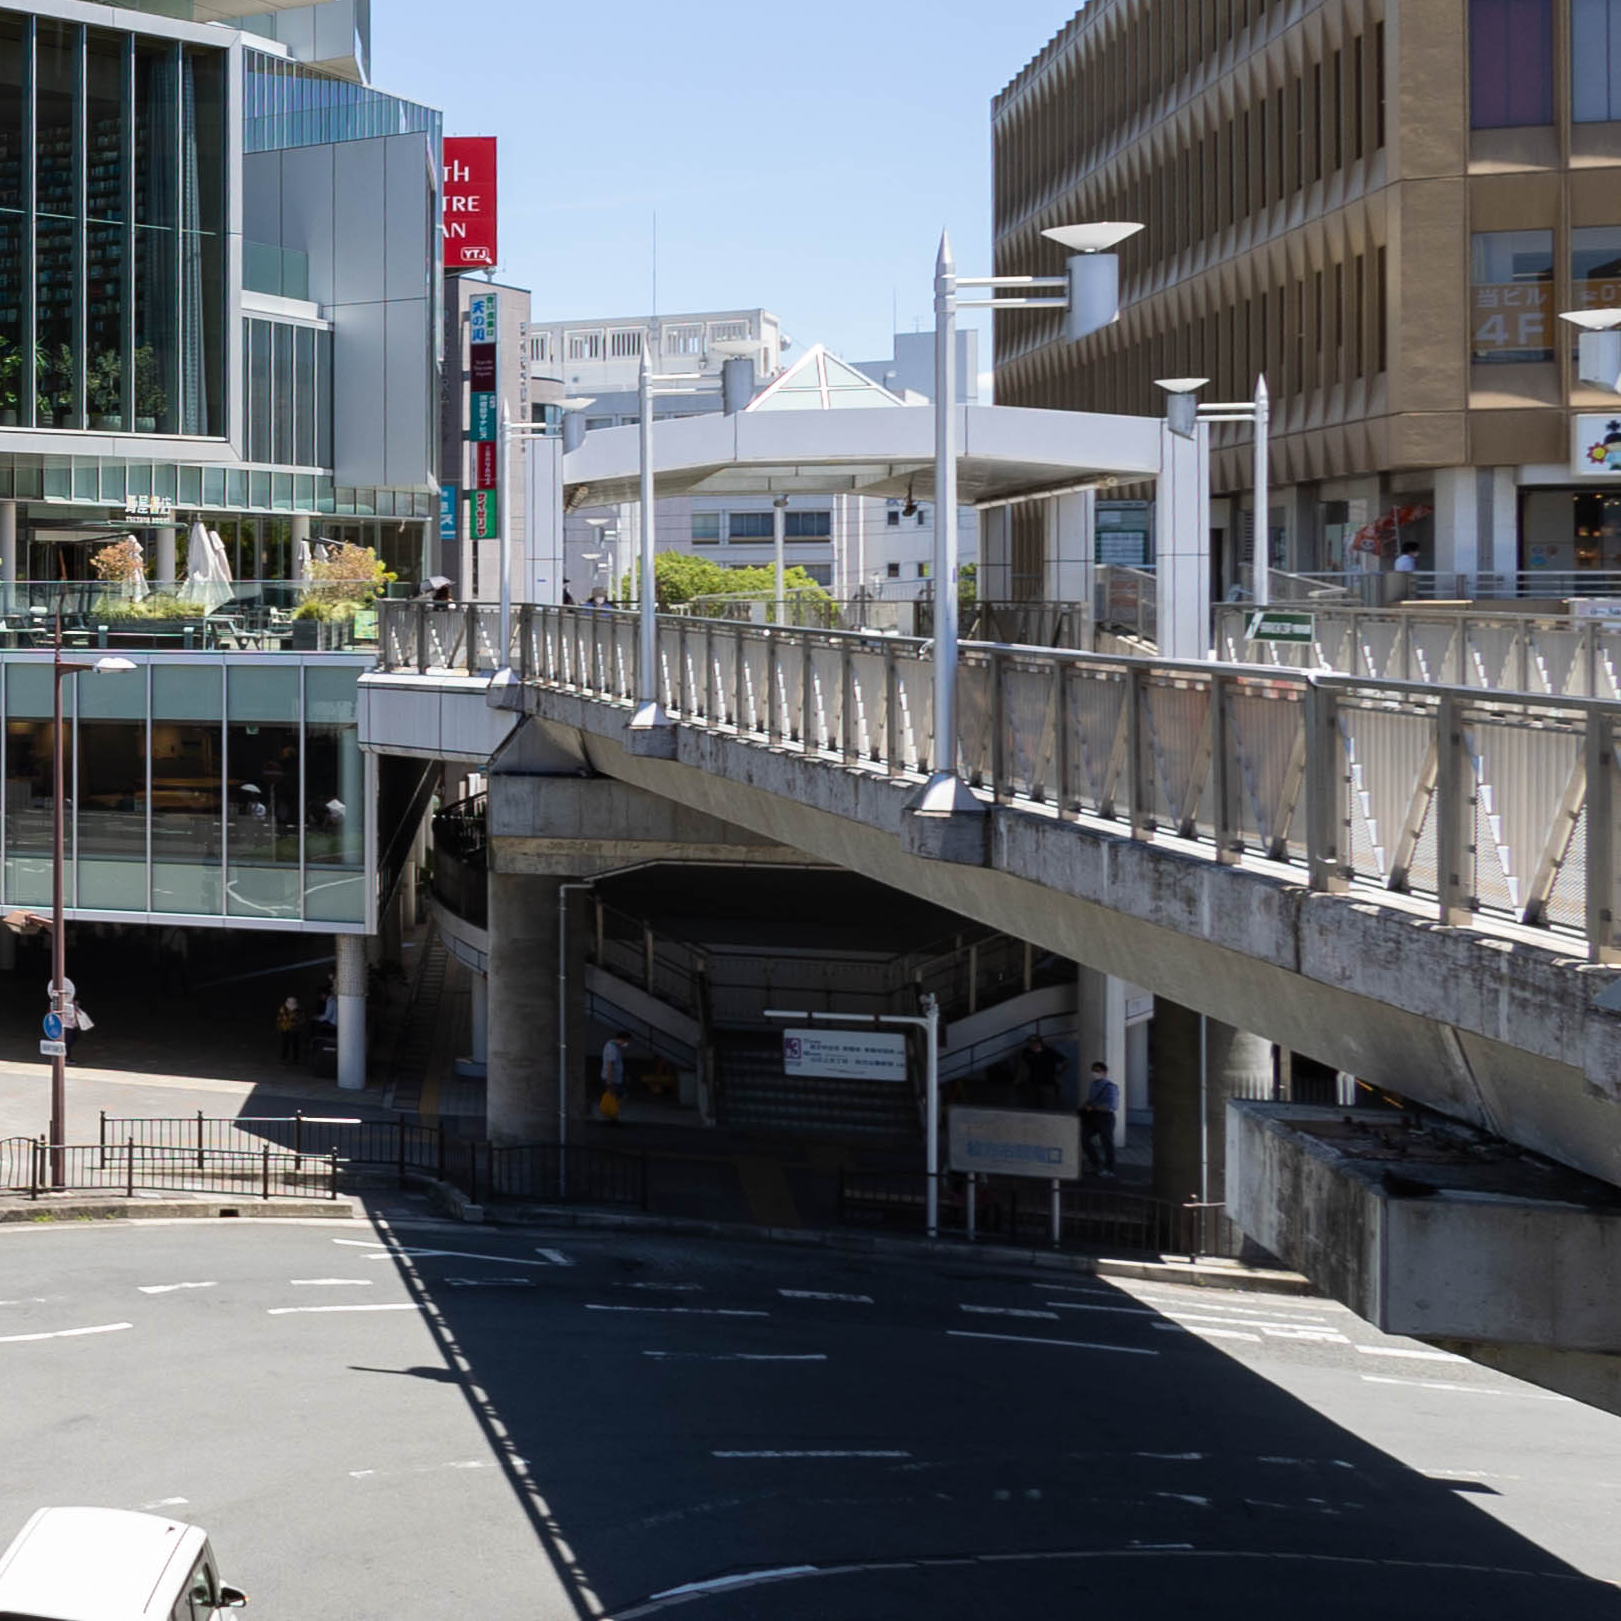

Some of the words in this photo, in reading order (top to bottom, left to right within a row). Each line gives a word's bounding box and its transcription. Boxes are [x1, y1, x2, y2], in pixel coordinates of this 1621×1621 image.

[464, 249, 487, 259] YTJ
[1476, 286, 1548, 308] 当ビル
[472, 300, 485, 341] 天の川
[1475, 313, 1545, 346] 4F
[476, 492, 487, 538] サイゼリヤ
